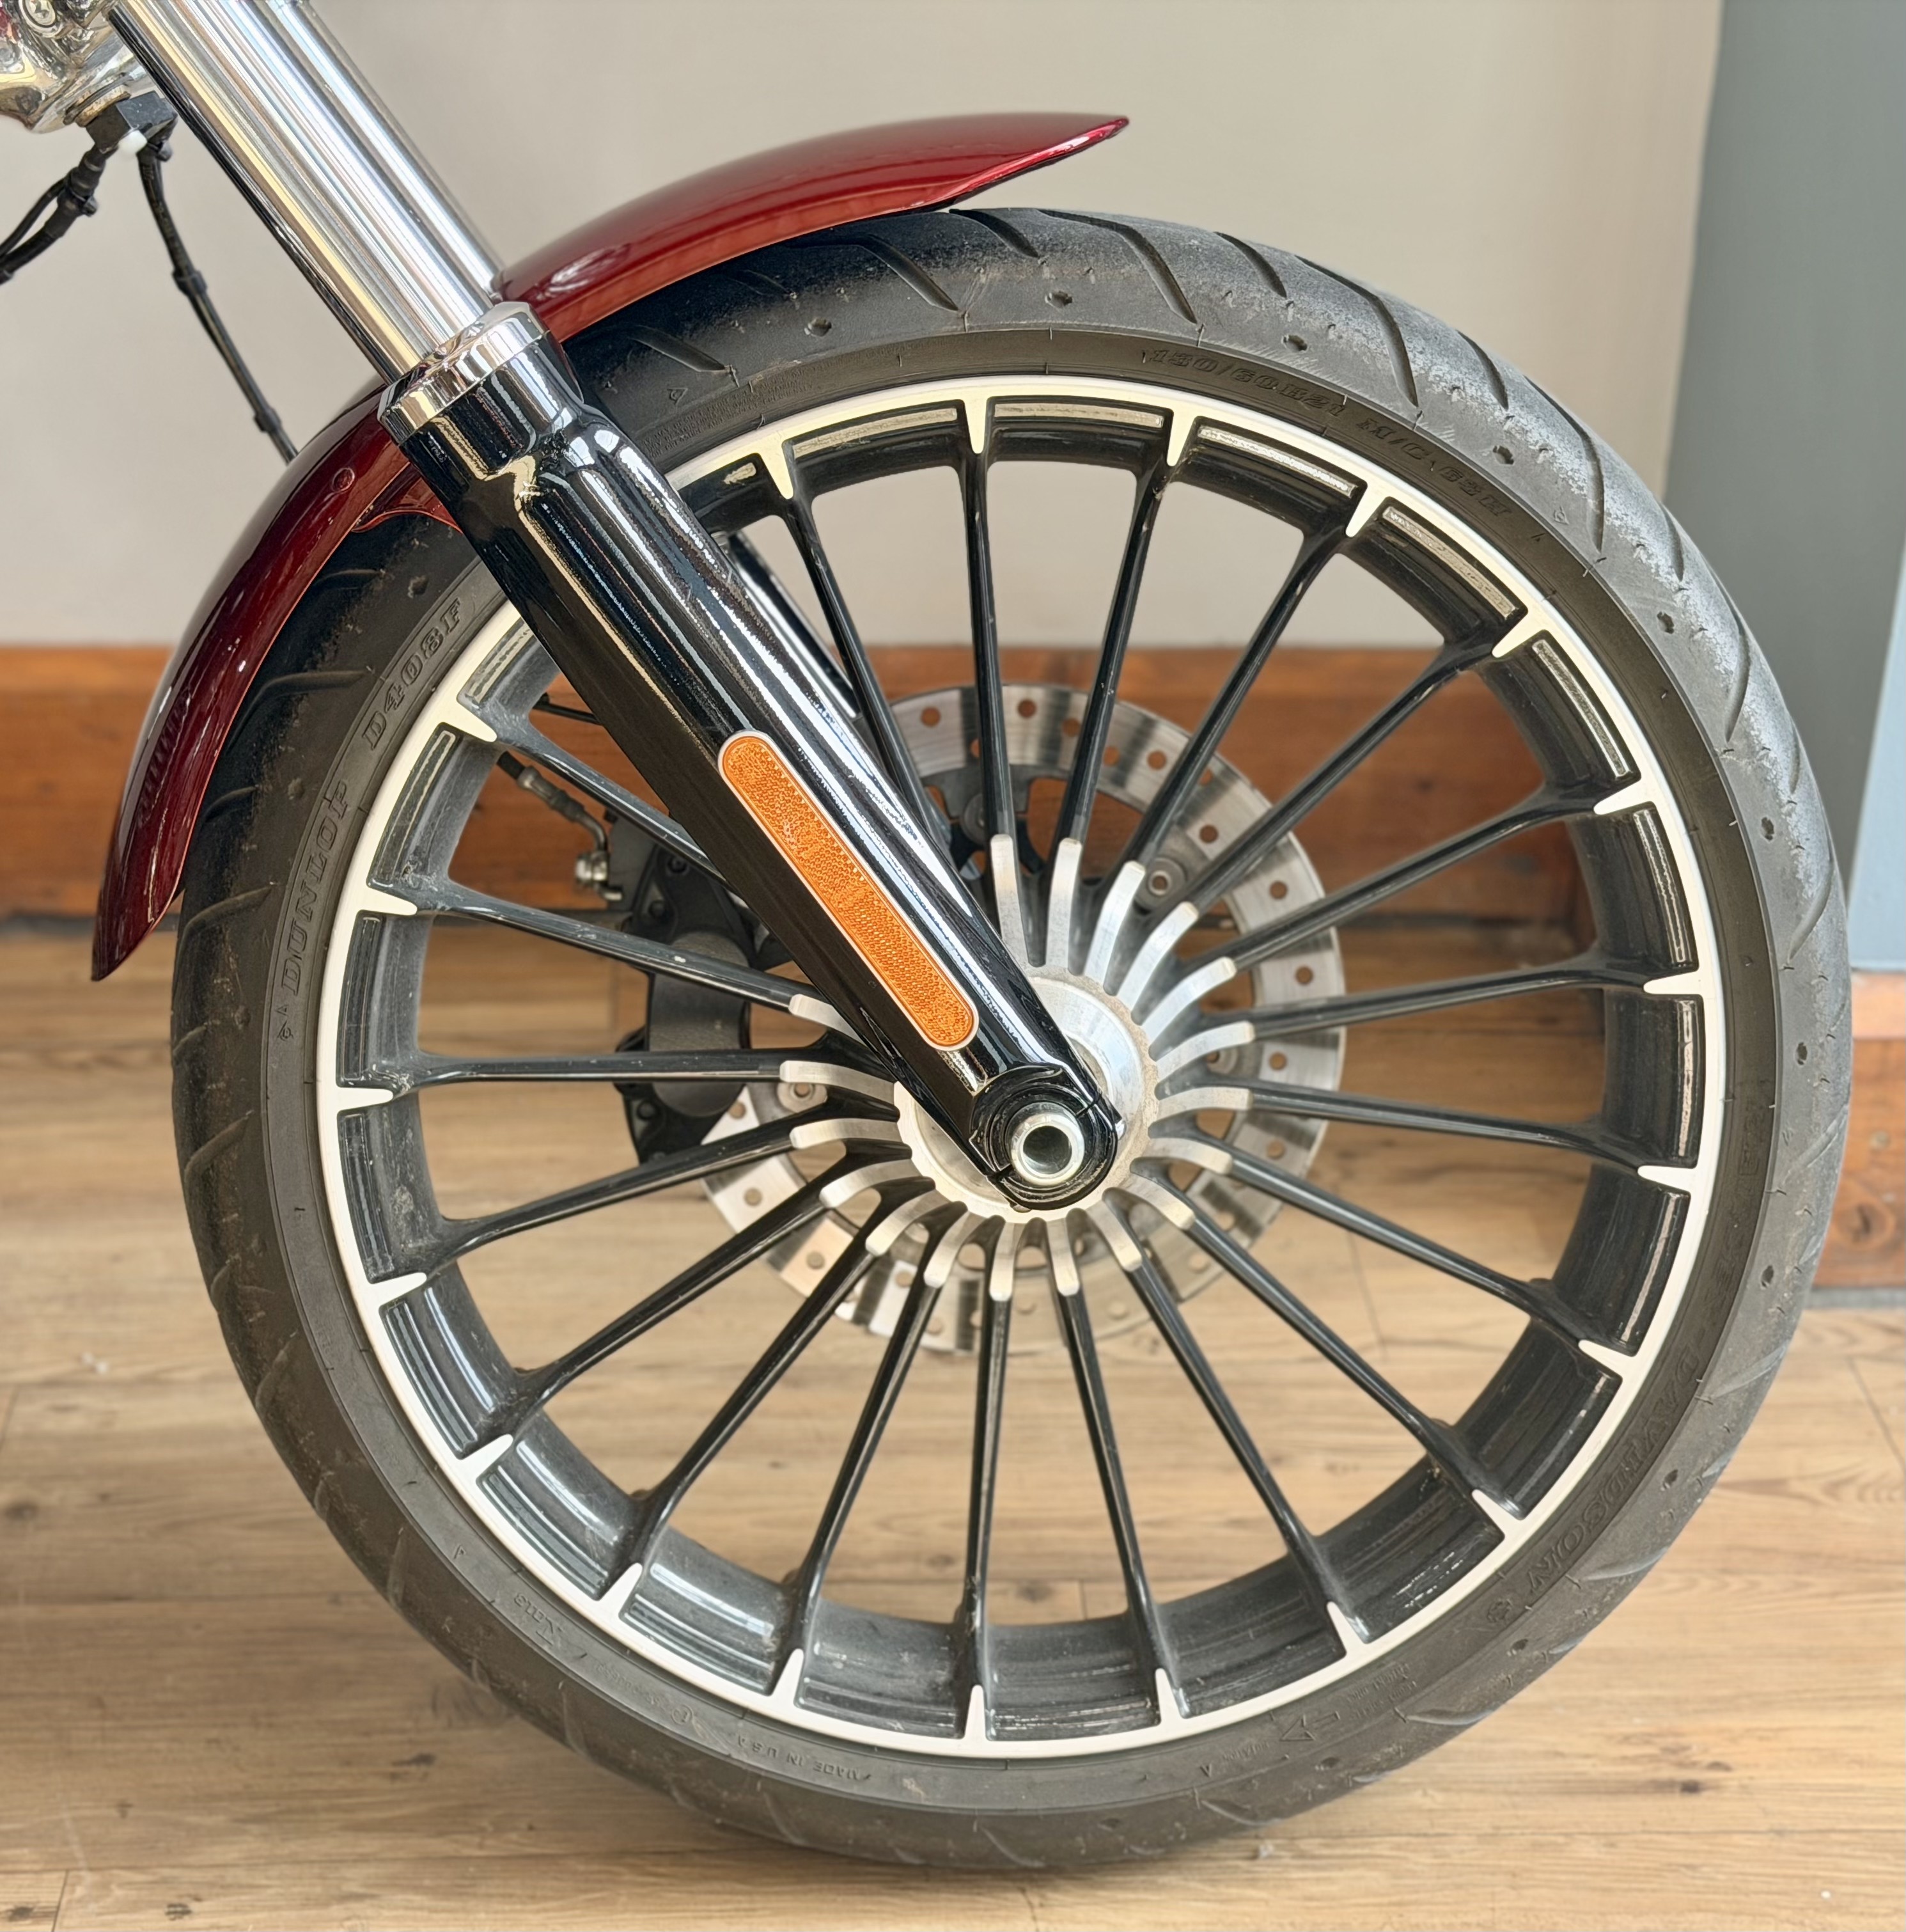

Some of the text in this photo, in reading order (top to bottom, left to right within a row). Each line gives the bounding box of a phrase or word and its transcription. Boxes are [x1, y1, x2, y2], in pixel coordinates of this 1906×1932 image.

[361, 597, 463, 751] D408F
[281, 780, 351, 997] DUNLOP
[1526, 1343, 1701, 1592] DAVIDSON
[786, 1750, 803, 1766] IN
[813, 1761, 861, 1780] MADE
